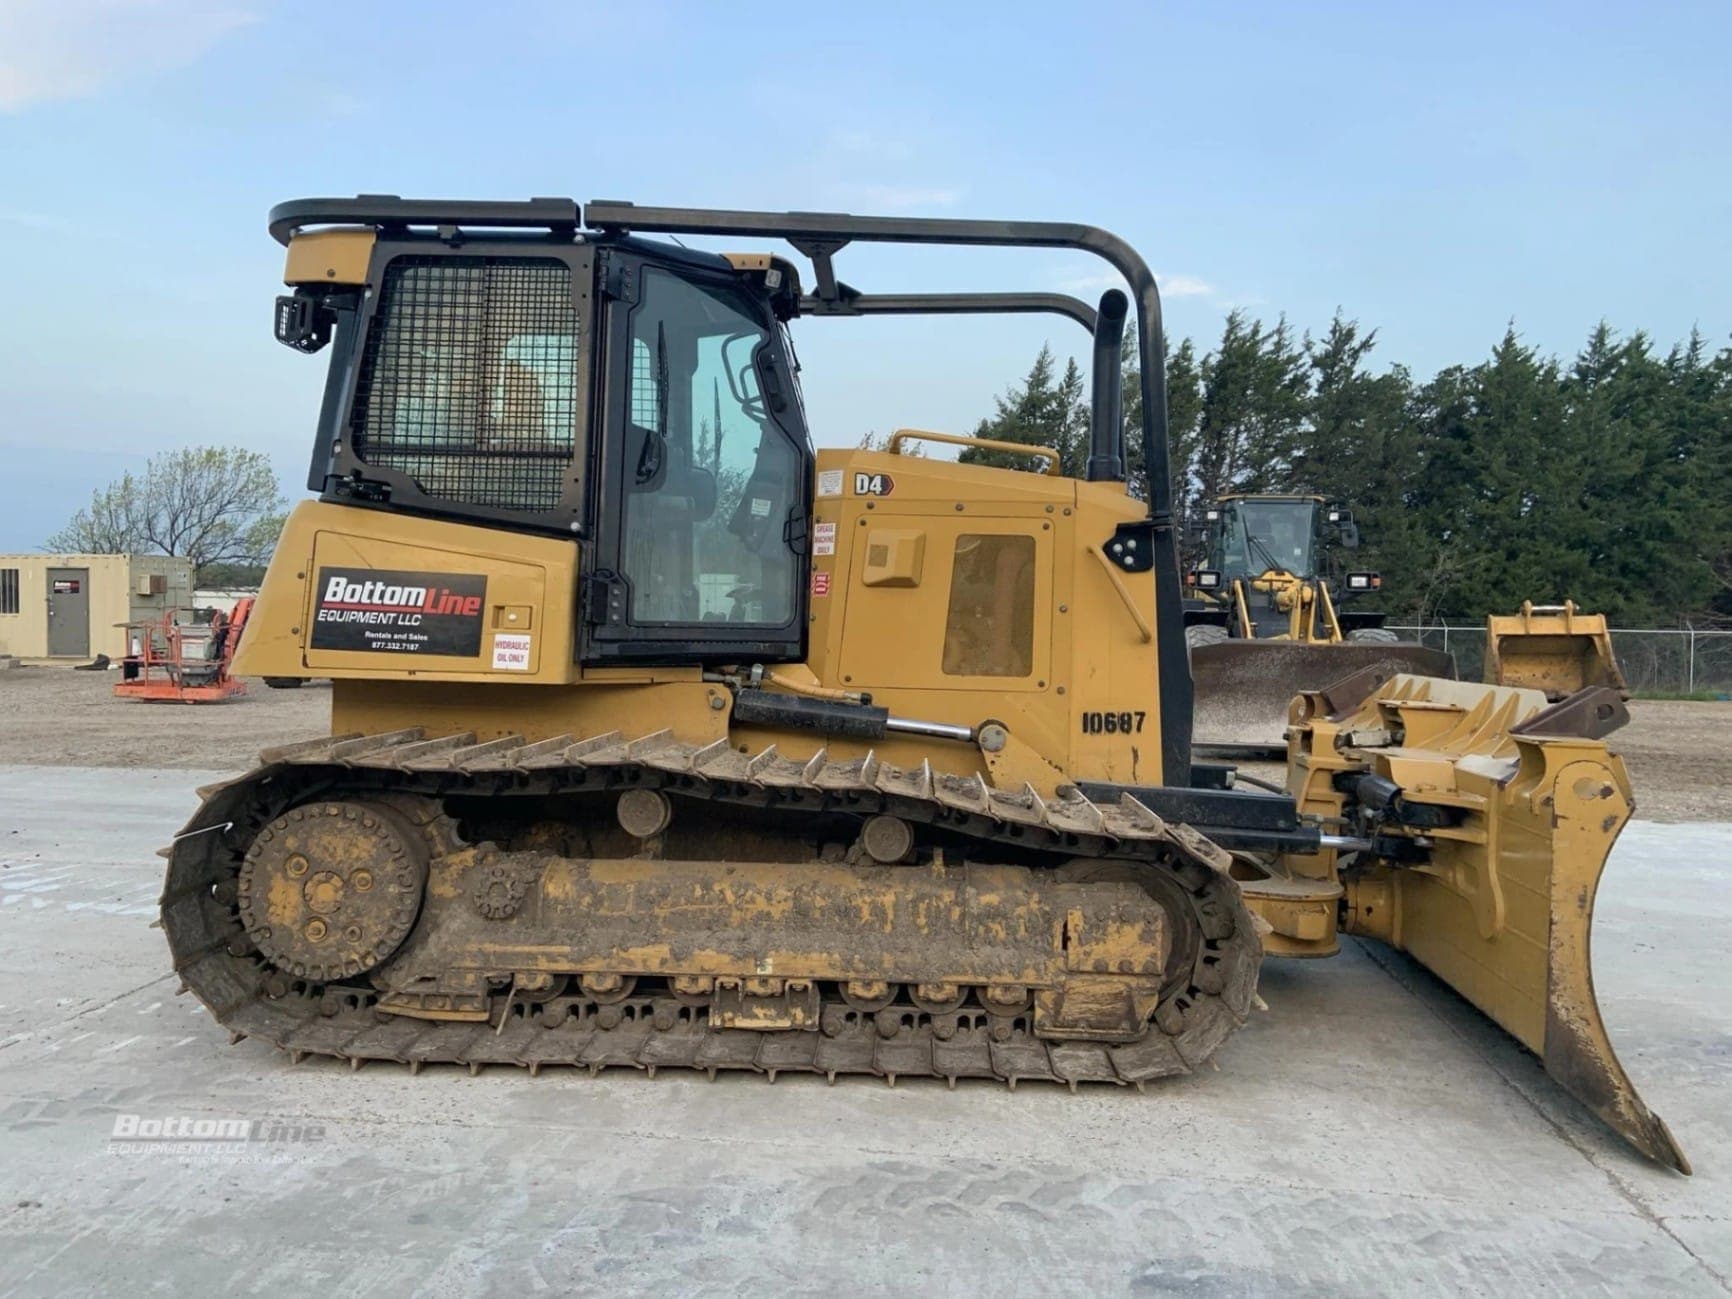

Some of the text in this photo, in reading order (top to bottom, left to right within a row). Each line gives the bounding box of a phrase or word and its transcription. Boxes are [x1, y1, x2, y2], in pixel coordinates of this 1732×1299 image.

[855, 474, 882, 494] D4
[318, 609, 422, 626] EQUIPMENT LLC
[364, 630, 428, 641] Rentals and Sales
[495, 640, 529, 650] HYDRAULIC
[497, 653, 524, 663] OIL ONLY
[1082, 711, 1146, 734] 10687
